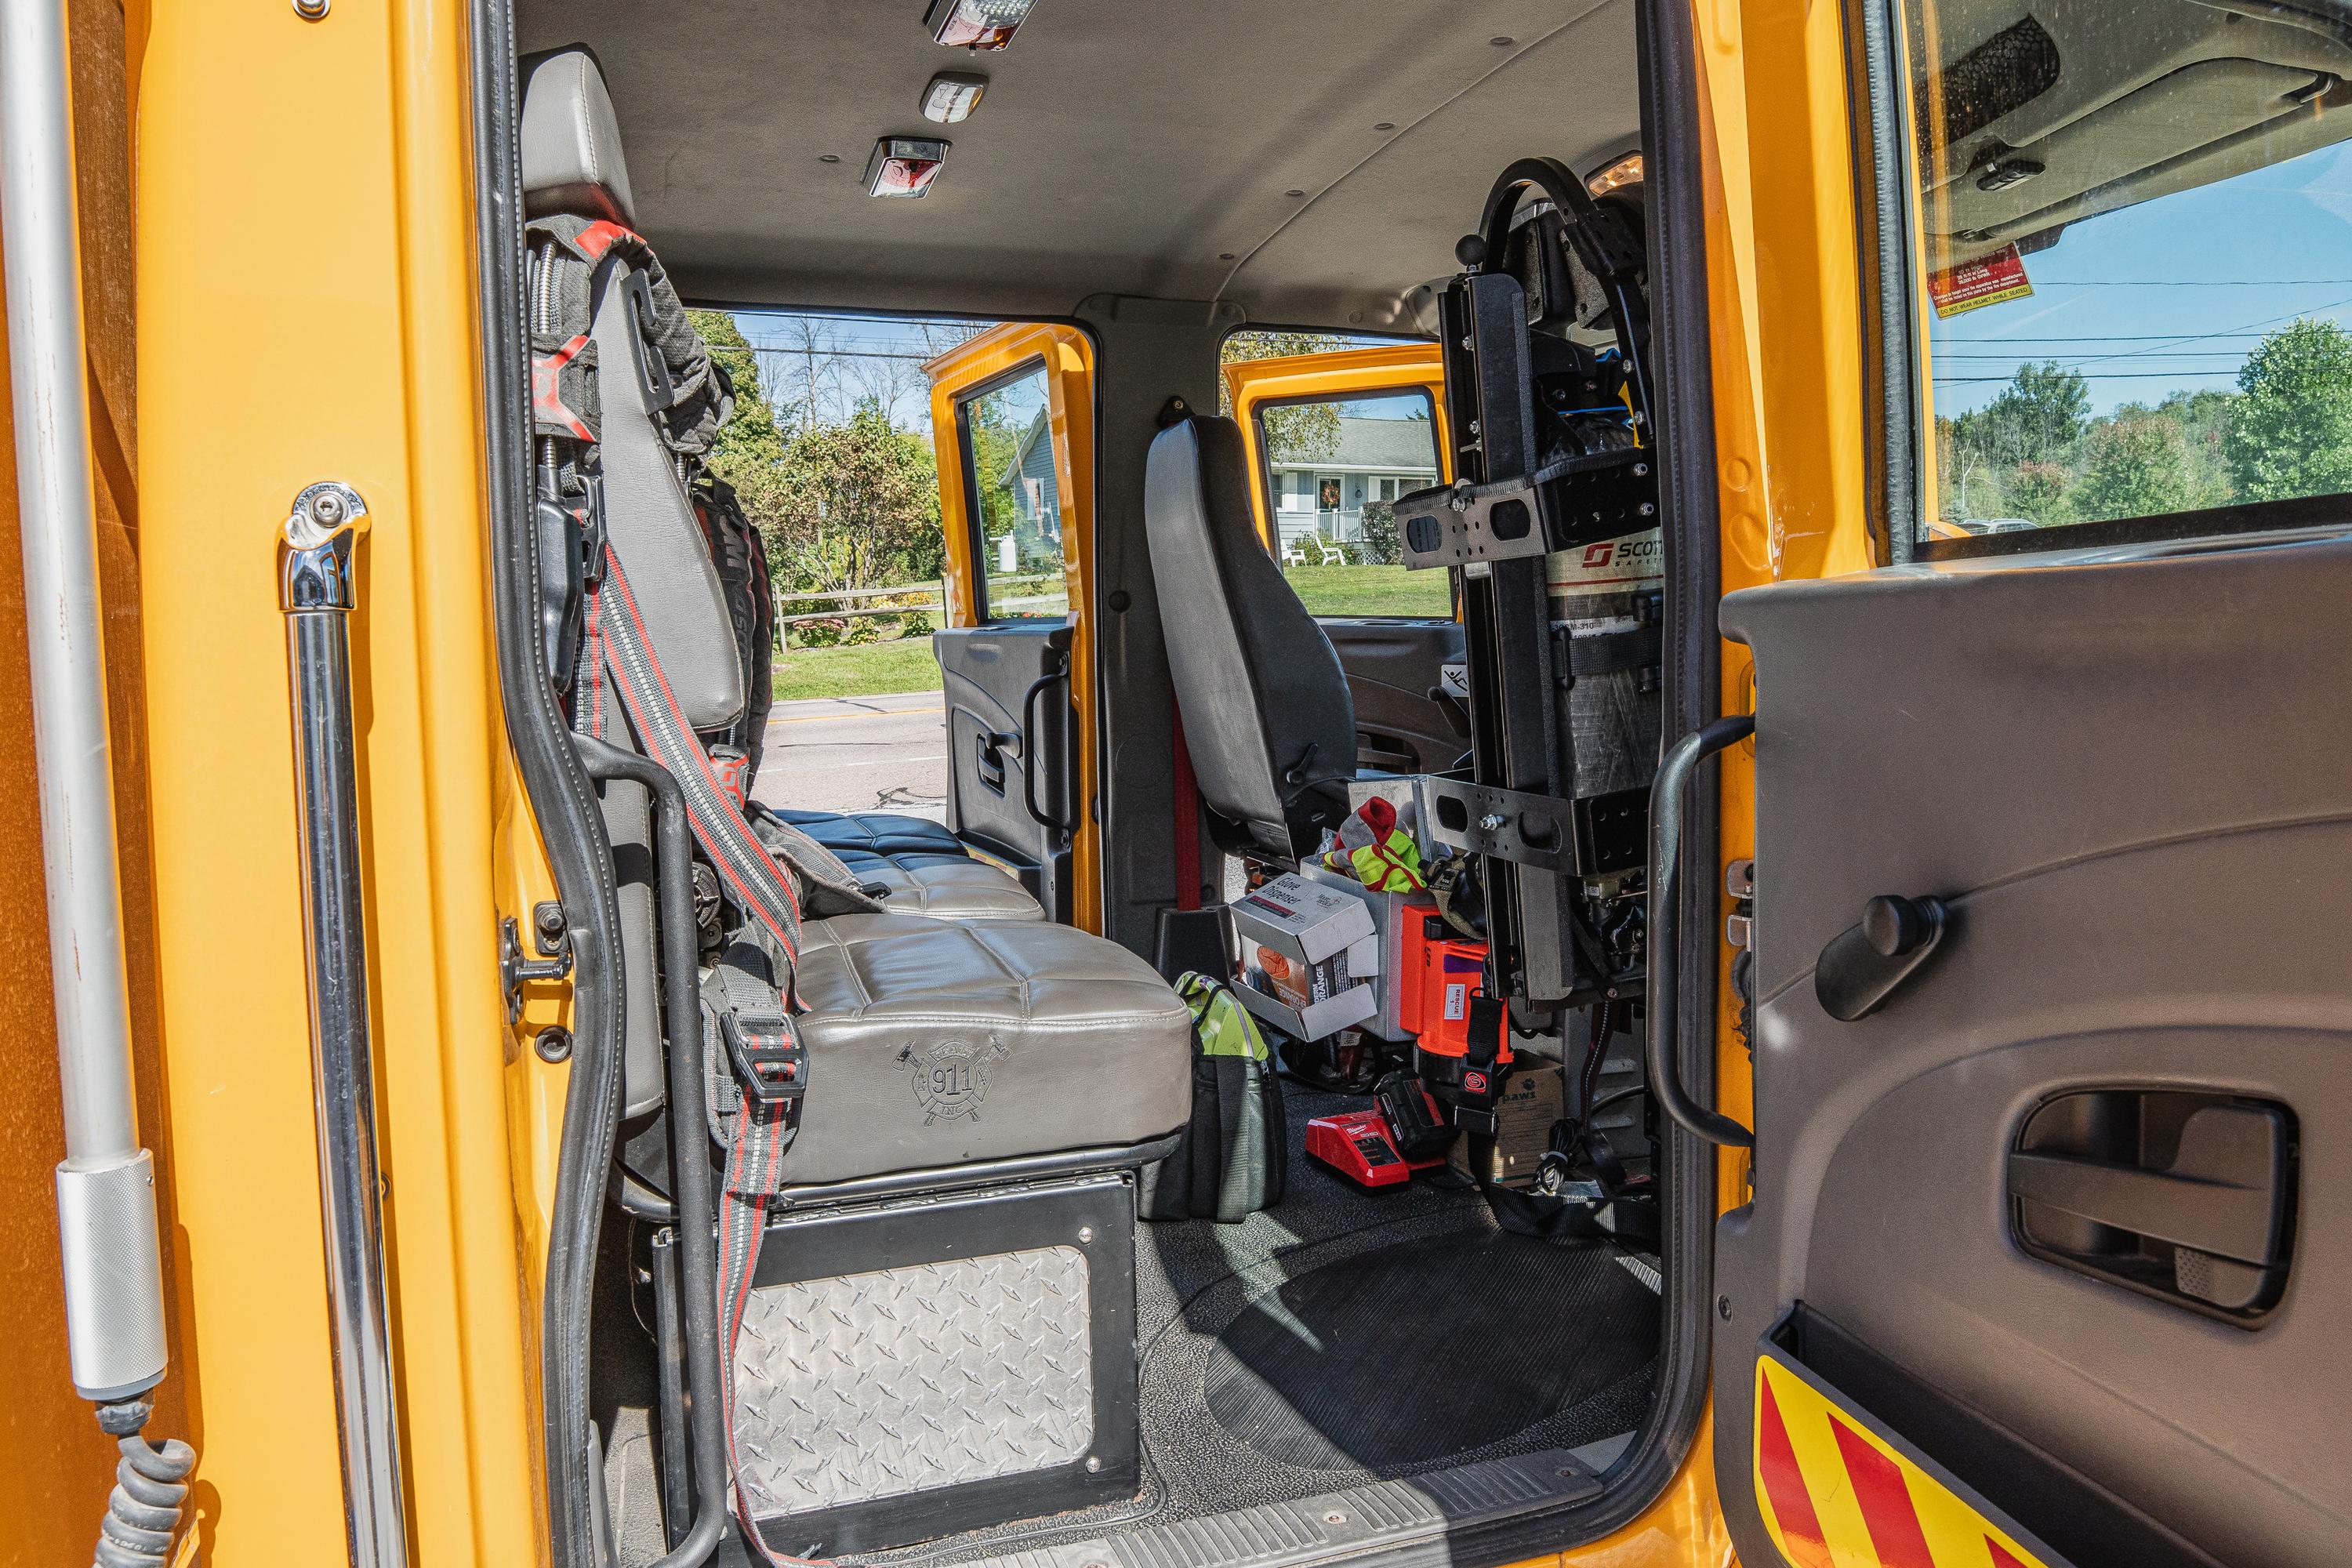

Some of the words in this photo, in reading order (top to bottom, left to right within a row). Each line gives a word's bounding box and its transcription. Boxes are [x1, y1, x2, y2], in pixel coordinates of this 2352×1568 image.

[1959, 301, 1973, 310] WEAR
[1973, 296, 1992, 306] HELMET
[1992, 292, 2007, 301] WHILE
[2009, 287, 2027, 296] SEATED
[1277, 877, 1301, 891] Glove
[1262, 886, 1301, 906] Dispenser
[932, 1063, 972, 1096] 911
[942, 1104, 964, 1116] INC
